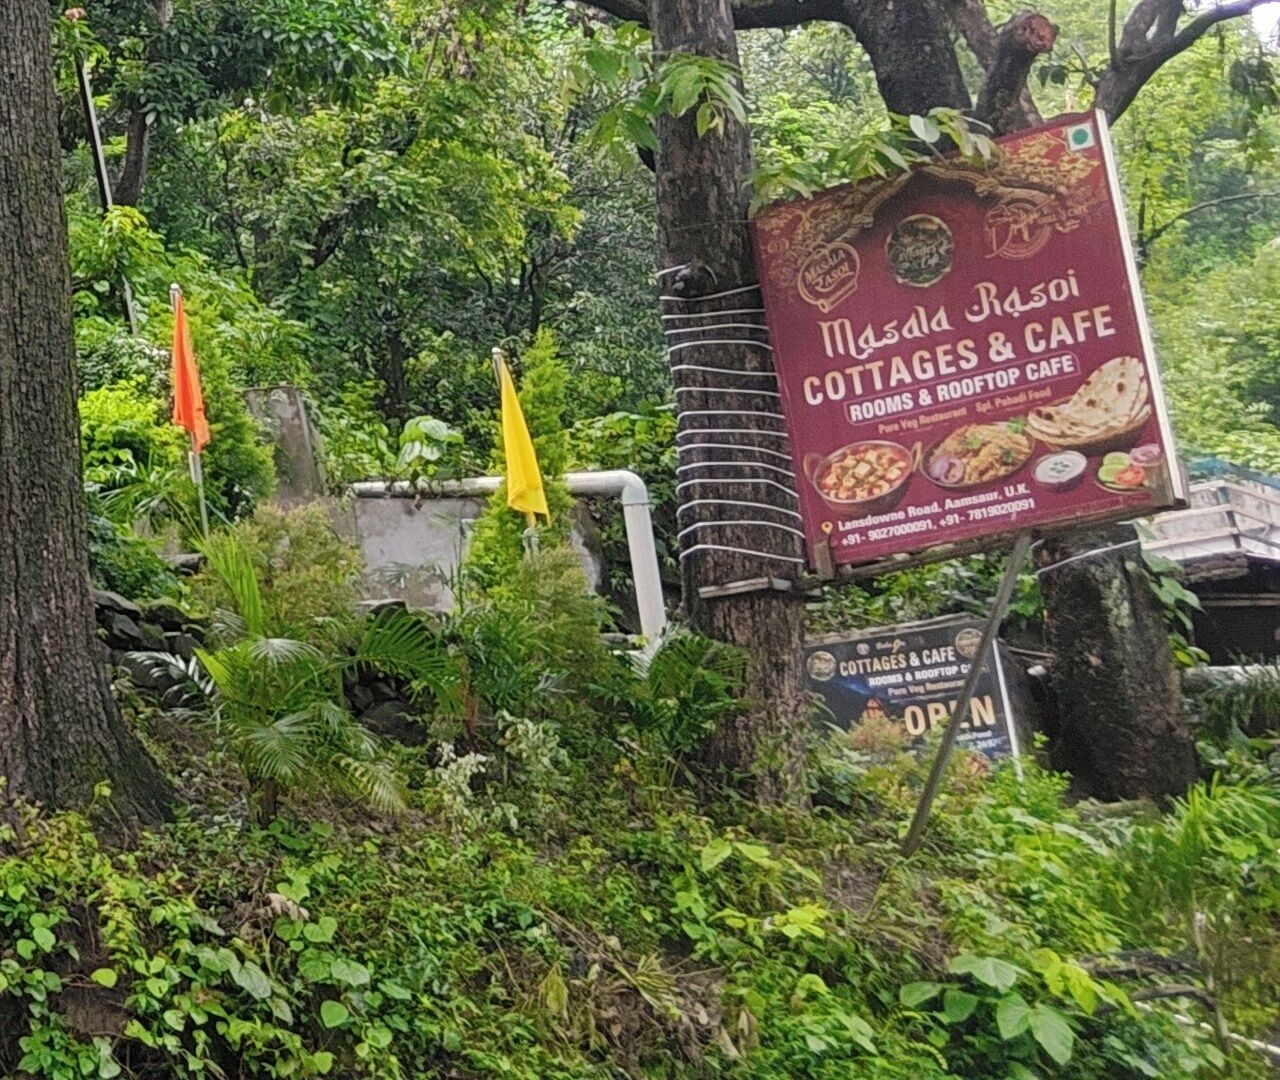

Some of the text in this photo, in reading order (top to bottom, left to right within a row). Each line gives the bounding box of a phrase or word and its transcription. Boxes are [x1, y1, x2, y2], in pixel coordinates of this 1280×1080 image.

[817, 269, 1081, 360] Masala Rasoi
[803, 304, 1117, 406] COTTAGES & CAFE
[849, 354, 1076, 423] ROOMS & ROOFTOP CAFE
[877, 421, 900, 435] Pure
[900, 416, 919, 430] Veg
[919, 406, 968, 427] Restaurant
[995, 391, 1028, 409] Pahadi
[1028, 386, 1052, 402] Food
[837, 510, 906, 532] Lansdowne
[1004, 483, 1032, 498] U.K.
[967, 498, 1036, 522] 7819020091
[840, 652, 907, 677] COTTAGES
[909, 651, 921, 667] &
[922, 646, 957, 665] CAFE
[868, 674, 903, 687] ROOMS
[905, 671, 913, 682] &
[914, 666, 959, 680] ROOFTOP
